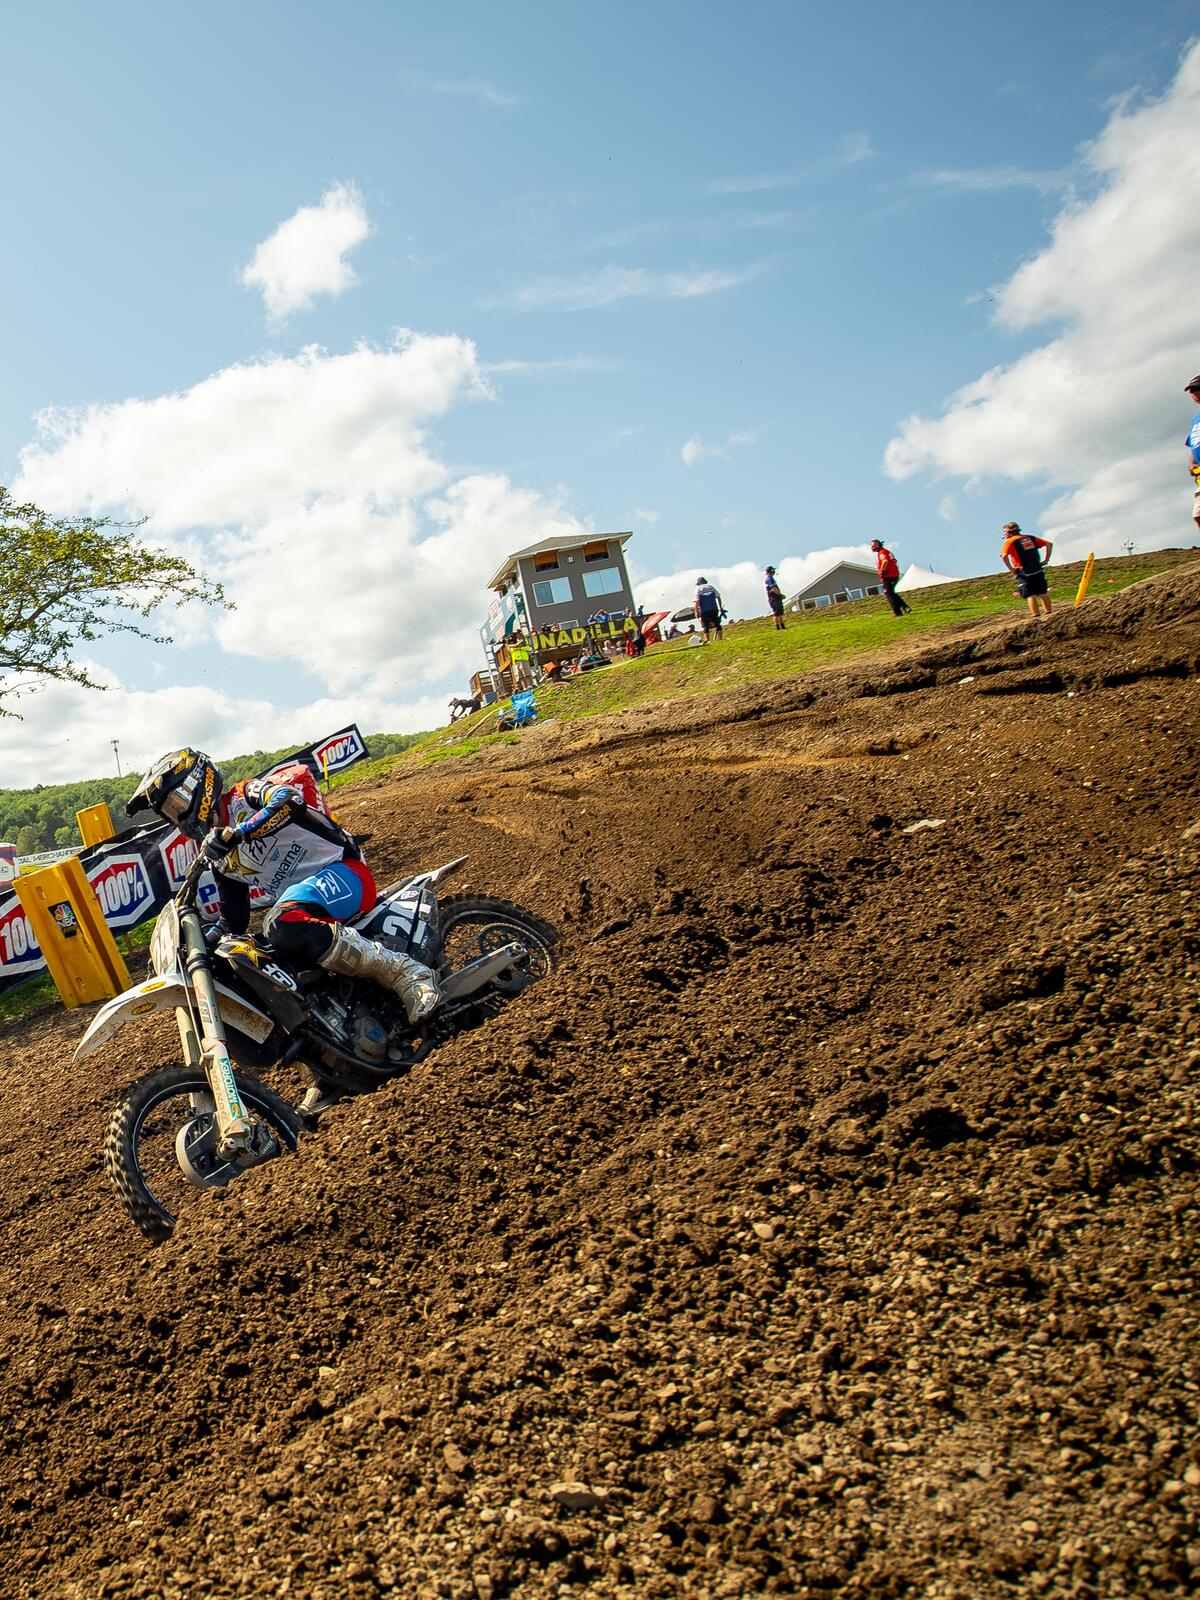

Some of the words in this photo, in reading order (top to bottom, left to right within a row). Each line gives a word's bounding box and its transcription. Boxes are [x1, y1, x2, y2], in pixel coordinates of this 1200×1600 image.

[197, 767, 214, 822] ROCKSTAR
[251, 805, 292, 839] ROCKSTAR
[95, 865, 144, 916] 100%
[382, 899, 432, 945] 24
[220, 1060, 238, 1104] MOTOREX
